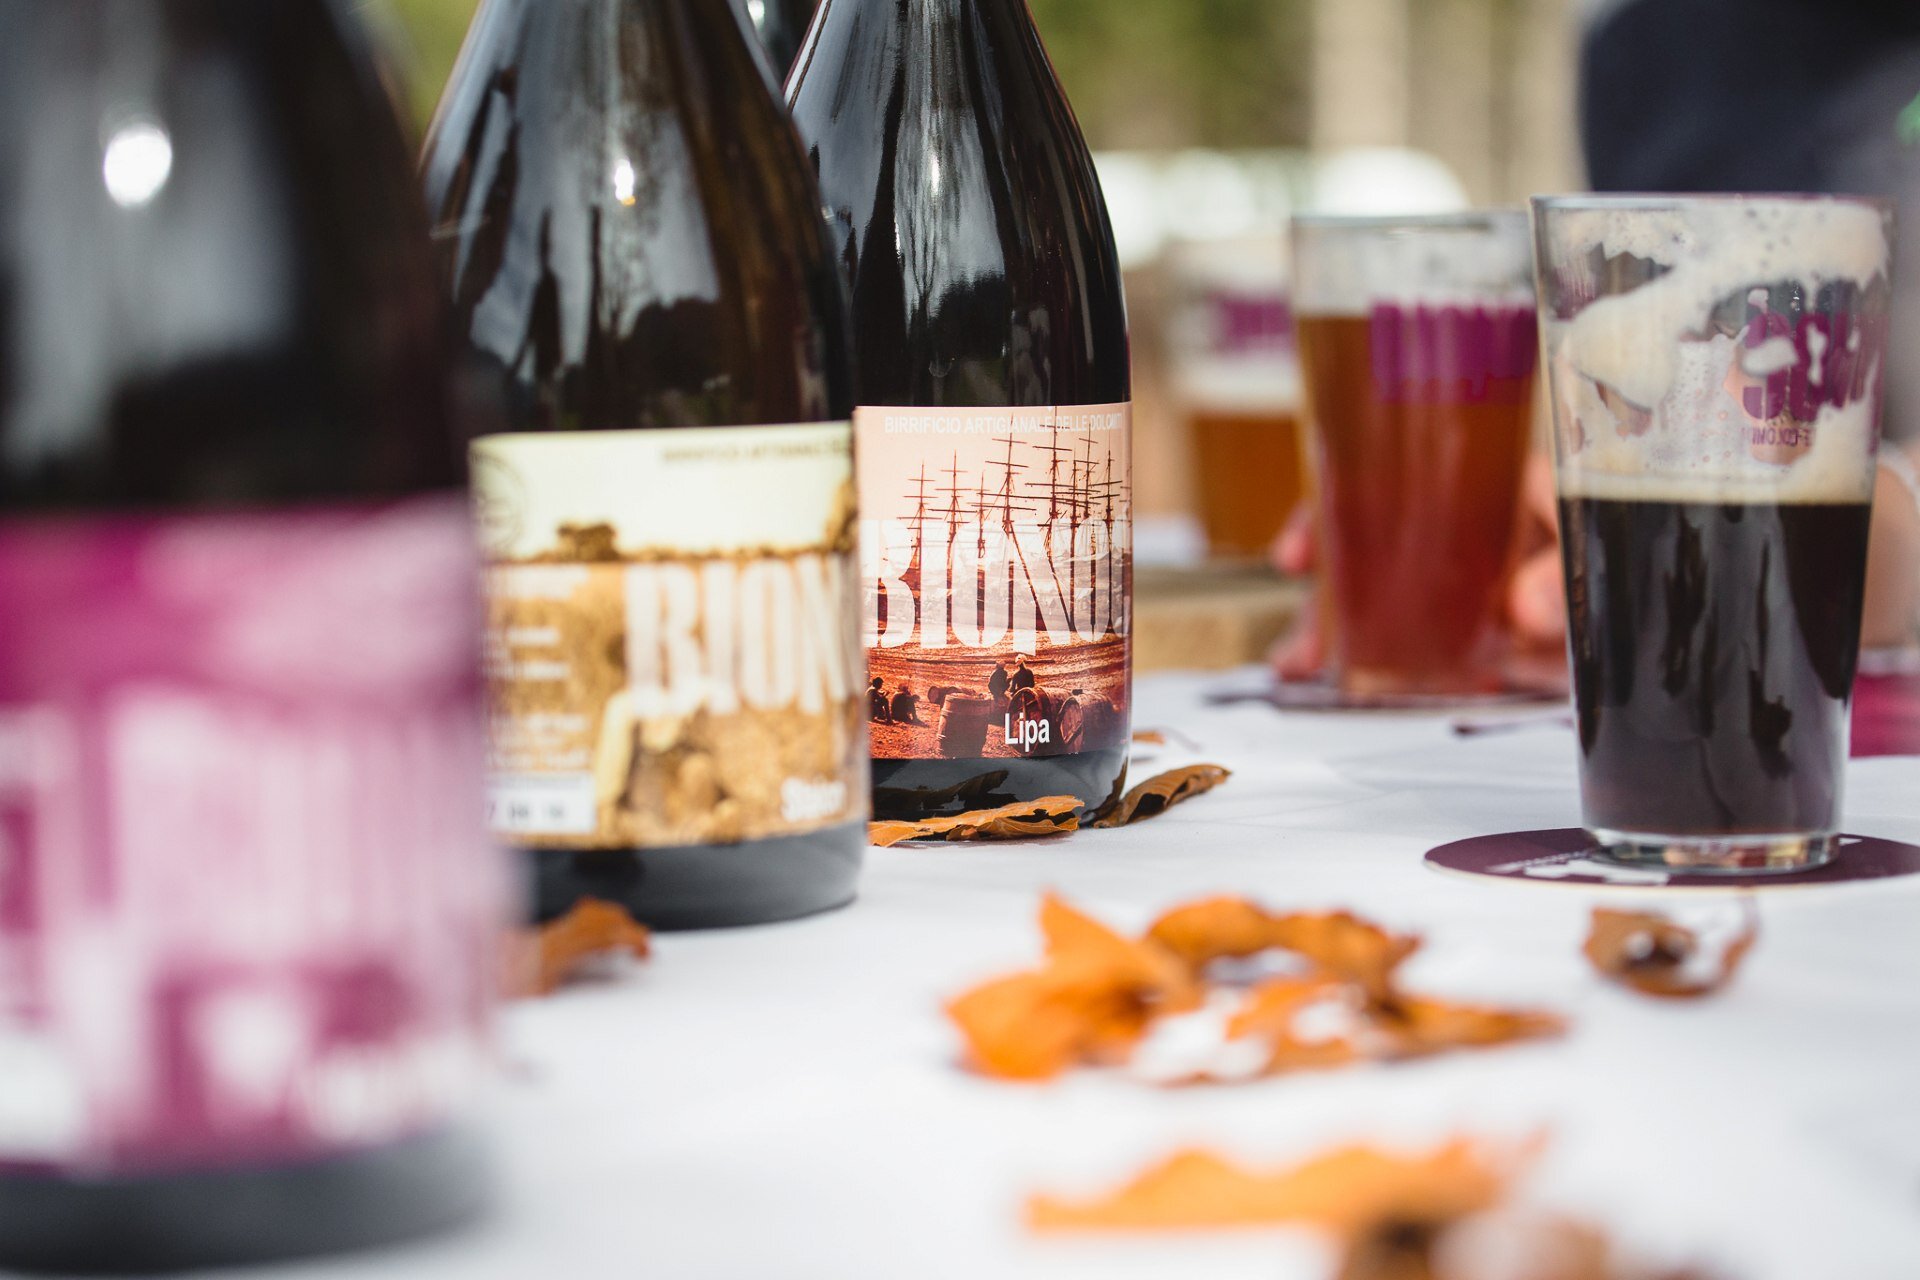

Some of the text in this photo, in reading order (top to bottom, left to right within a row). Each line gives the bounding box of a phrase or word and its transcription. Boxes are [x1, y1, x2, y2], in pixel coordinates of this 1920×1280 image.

[885, 415, 960, 433] BIRRIFICIO
[965, 415, 1053, 433] ARTIGIANALE
[1004, 712, 1050, 752] Lipa
